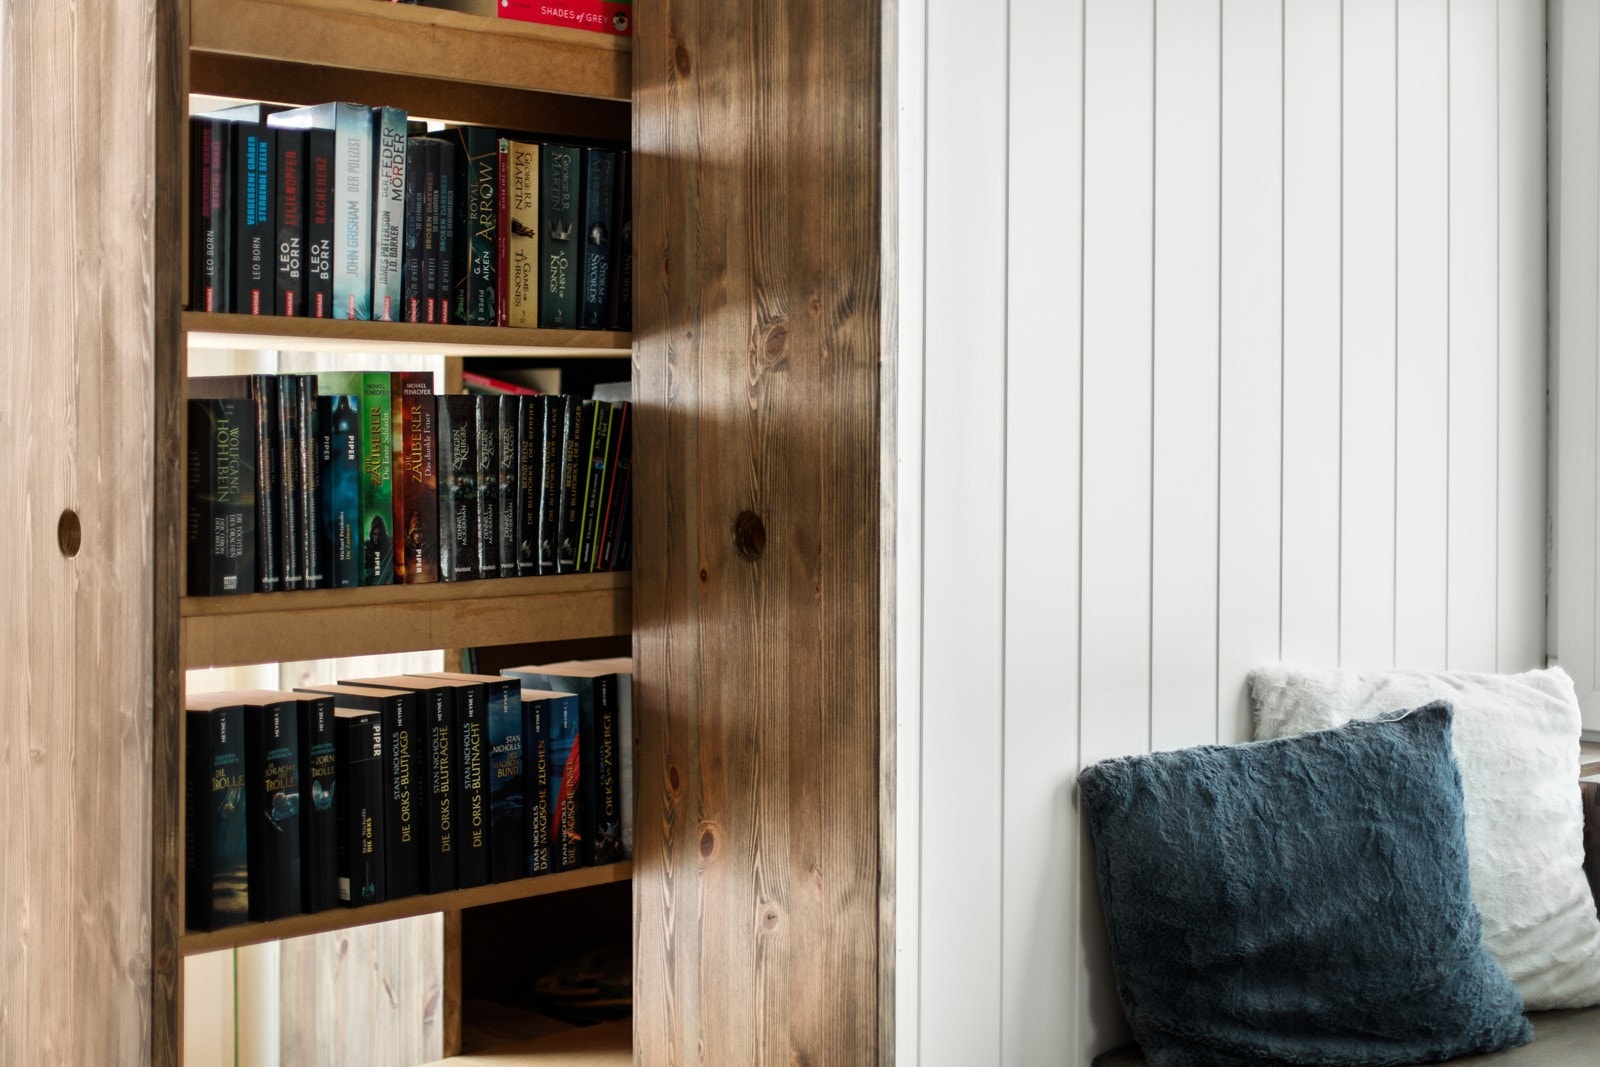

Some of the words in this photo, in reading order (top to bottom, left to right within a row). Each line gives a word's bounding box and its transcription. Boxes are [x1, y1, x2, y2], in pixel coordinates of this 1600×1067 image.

[541, 6, 575, 18] SHADES
[576, 12, 585, 22] of
[586, 14, 608, 24] GREY
[246, 136, 255, 170] GRÄBER
[259, 142, 267, 171] SEELEN
[348, 137, 360, 173] POLIZIST
[382, 127, 393, 177] FEDER
[389, 134, 404, 201] MÖRDER
[285, 151, 297, 225] LILIENOPFER
[316, 156, 326, 224] RACHEHERZ
[348, 177, 359, 192] DER
[516, 151, 524, 210] MARTIN
[552, 152, 560, 211] MARTIN
[561, 154, 570, 194] GEORGE
[247, 172, 255, 225] VERGESSENE
[259, 174, 267, 222] STERBENDE
[470, 183, 478, 219] ROYAL
[476, 162, 494, 240] ARROW
[347, 201, 359, 247] GRISHAM
[381, 211, 390, 257] PATTERSON
[390, 226, 399, 257] BARKER
[206, 259, 214, 276] LEO
[252, 264, 260, 279] LEO
[281, 242, 289, 271] LEO
[291, 238, 299, 278] BORN
[311, 245, 319, 273] LEO
[321, 240, 329, 279] BORN
[347, 249, 358, 277] JOHN
[380, 260, 388, 285] JAMES
[550, 254, 559, 293] KINGS
[559, 258, 568, 289] CLASH
[515, 250, 524, 307] THRONES
[590, 253, 599, 304] SWORDS
[599, 262, 608, 295] STORM
[371, 406, 382, 486] ZAUBERER
[411, 404, 423, 483] ZAUBERER
[452, 429, 463, 470] ZWERGEN
[460, 421, 469, 460] KRIEGER
[480, 429, 490, 469] ZWERGEN
[217, 419, 229, 502] HOHLBEIN
[229, 428, 239, 494] WOLFGANG
[373, 725, 381, 756] PIPER
[392, 732, 400, 774] NICHOLLS
[492, 743, 520, 753] NICHOLLS
[506, 735, 520, 743] STAN
[215, 769, 225, 777] DIE
[311, 767, 336, 778] TROLLE
[316, 755, 335, 765] ZORN
[498, 766, 518, 778] BUND
[566, 760, 574, 787] INSEL
[212, 775, 244, 791] TROLLE
[265, 778, 296, 792] TROLLE
[605, 776, 614, 816] ORKS
[401, 824, 411, 842] DIE
[539, 788, 547, 844] MAGISCHE
[566, 790, 575, 844] MAGISCHE
[441, 833, 451, 852] DIE
[472, 829, 482, 848] DIE
[567, 847, 576, 864] DIE
[540, 847, 548, 870] DAS
